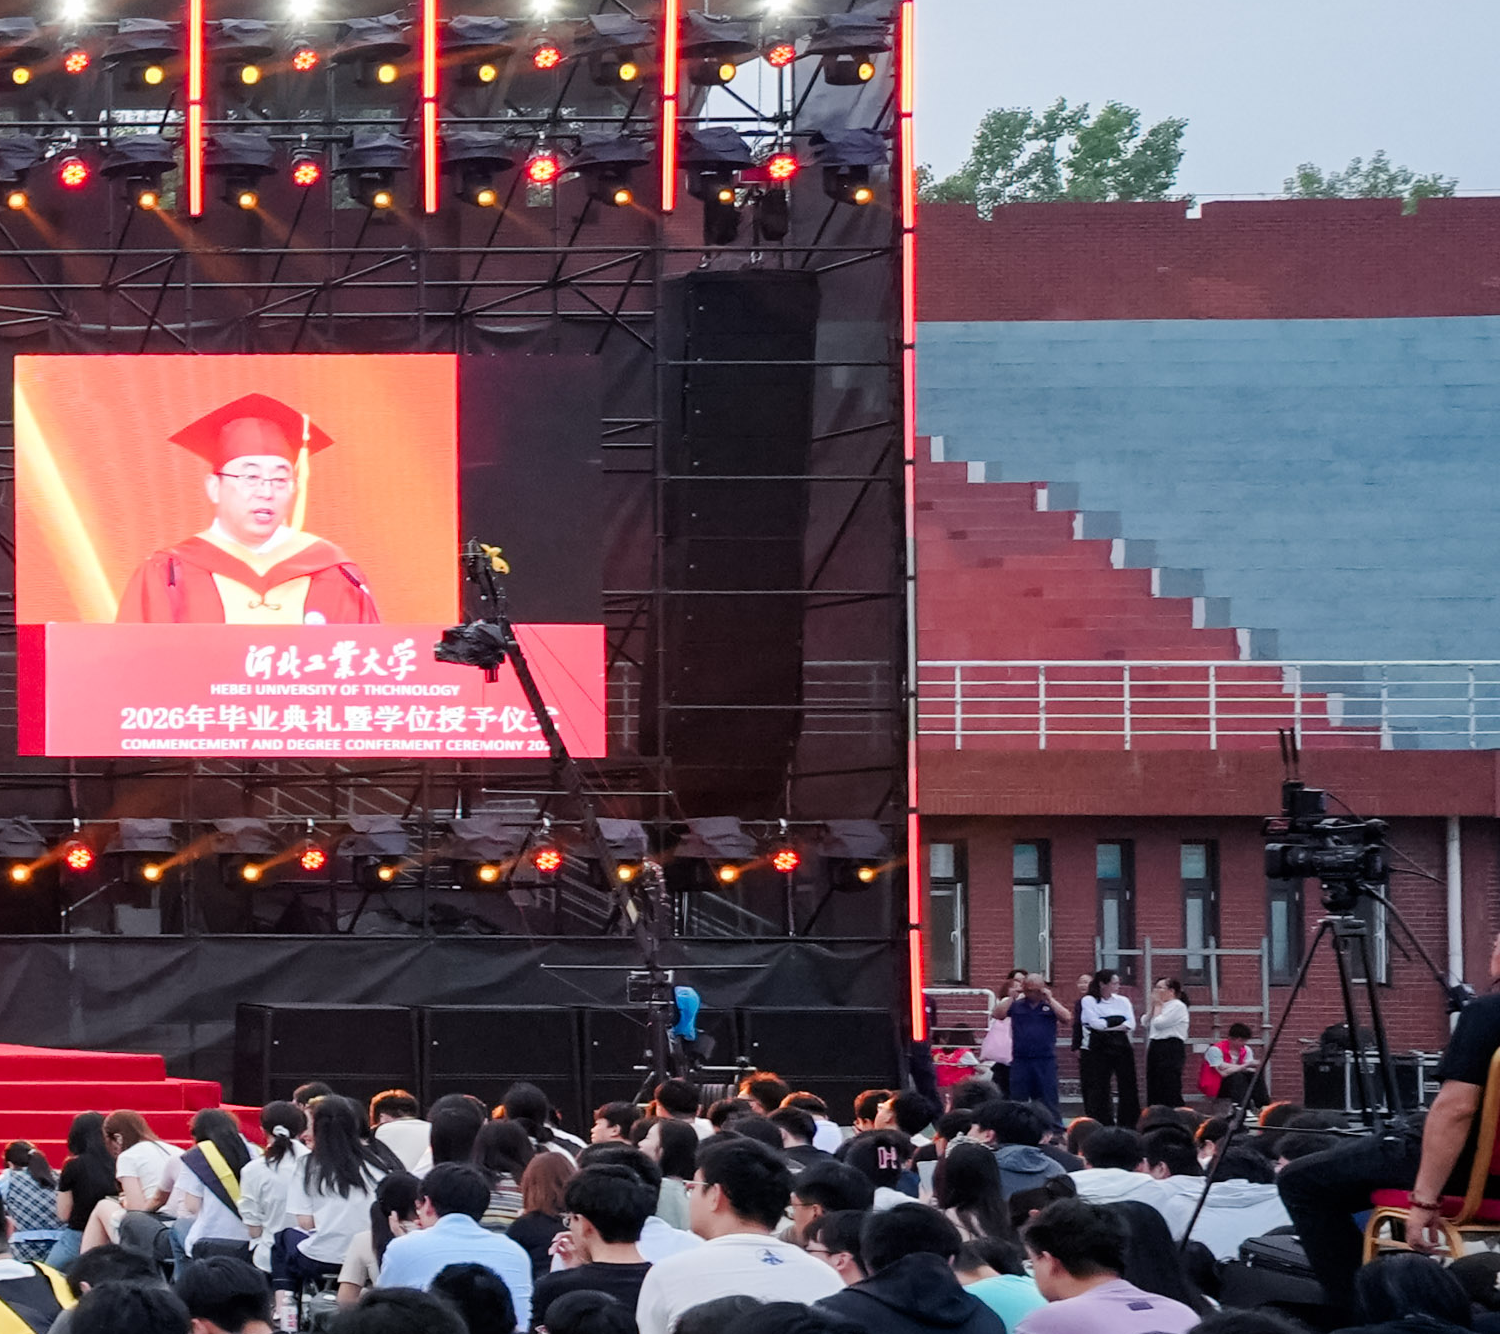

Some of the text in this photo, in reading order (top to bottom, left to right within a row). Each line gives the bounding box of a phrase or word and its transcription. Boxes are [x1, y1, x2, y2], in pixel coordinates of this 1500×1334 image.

[210, 684, 252, 696] HEBEI
[255, 684, 337, 696] UNIVERSITY
[340, 684, 360, 696] OF
[120, 738, 249, 751] COMMENCEMENT
[251, 738, 284, 751] AND
[286, 738, 342, 751] DEGREE
[344, 738, 443, 751] CONFERMENT
[445, 739, 525, 752] CEREMONY
